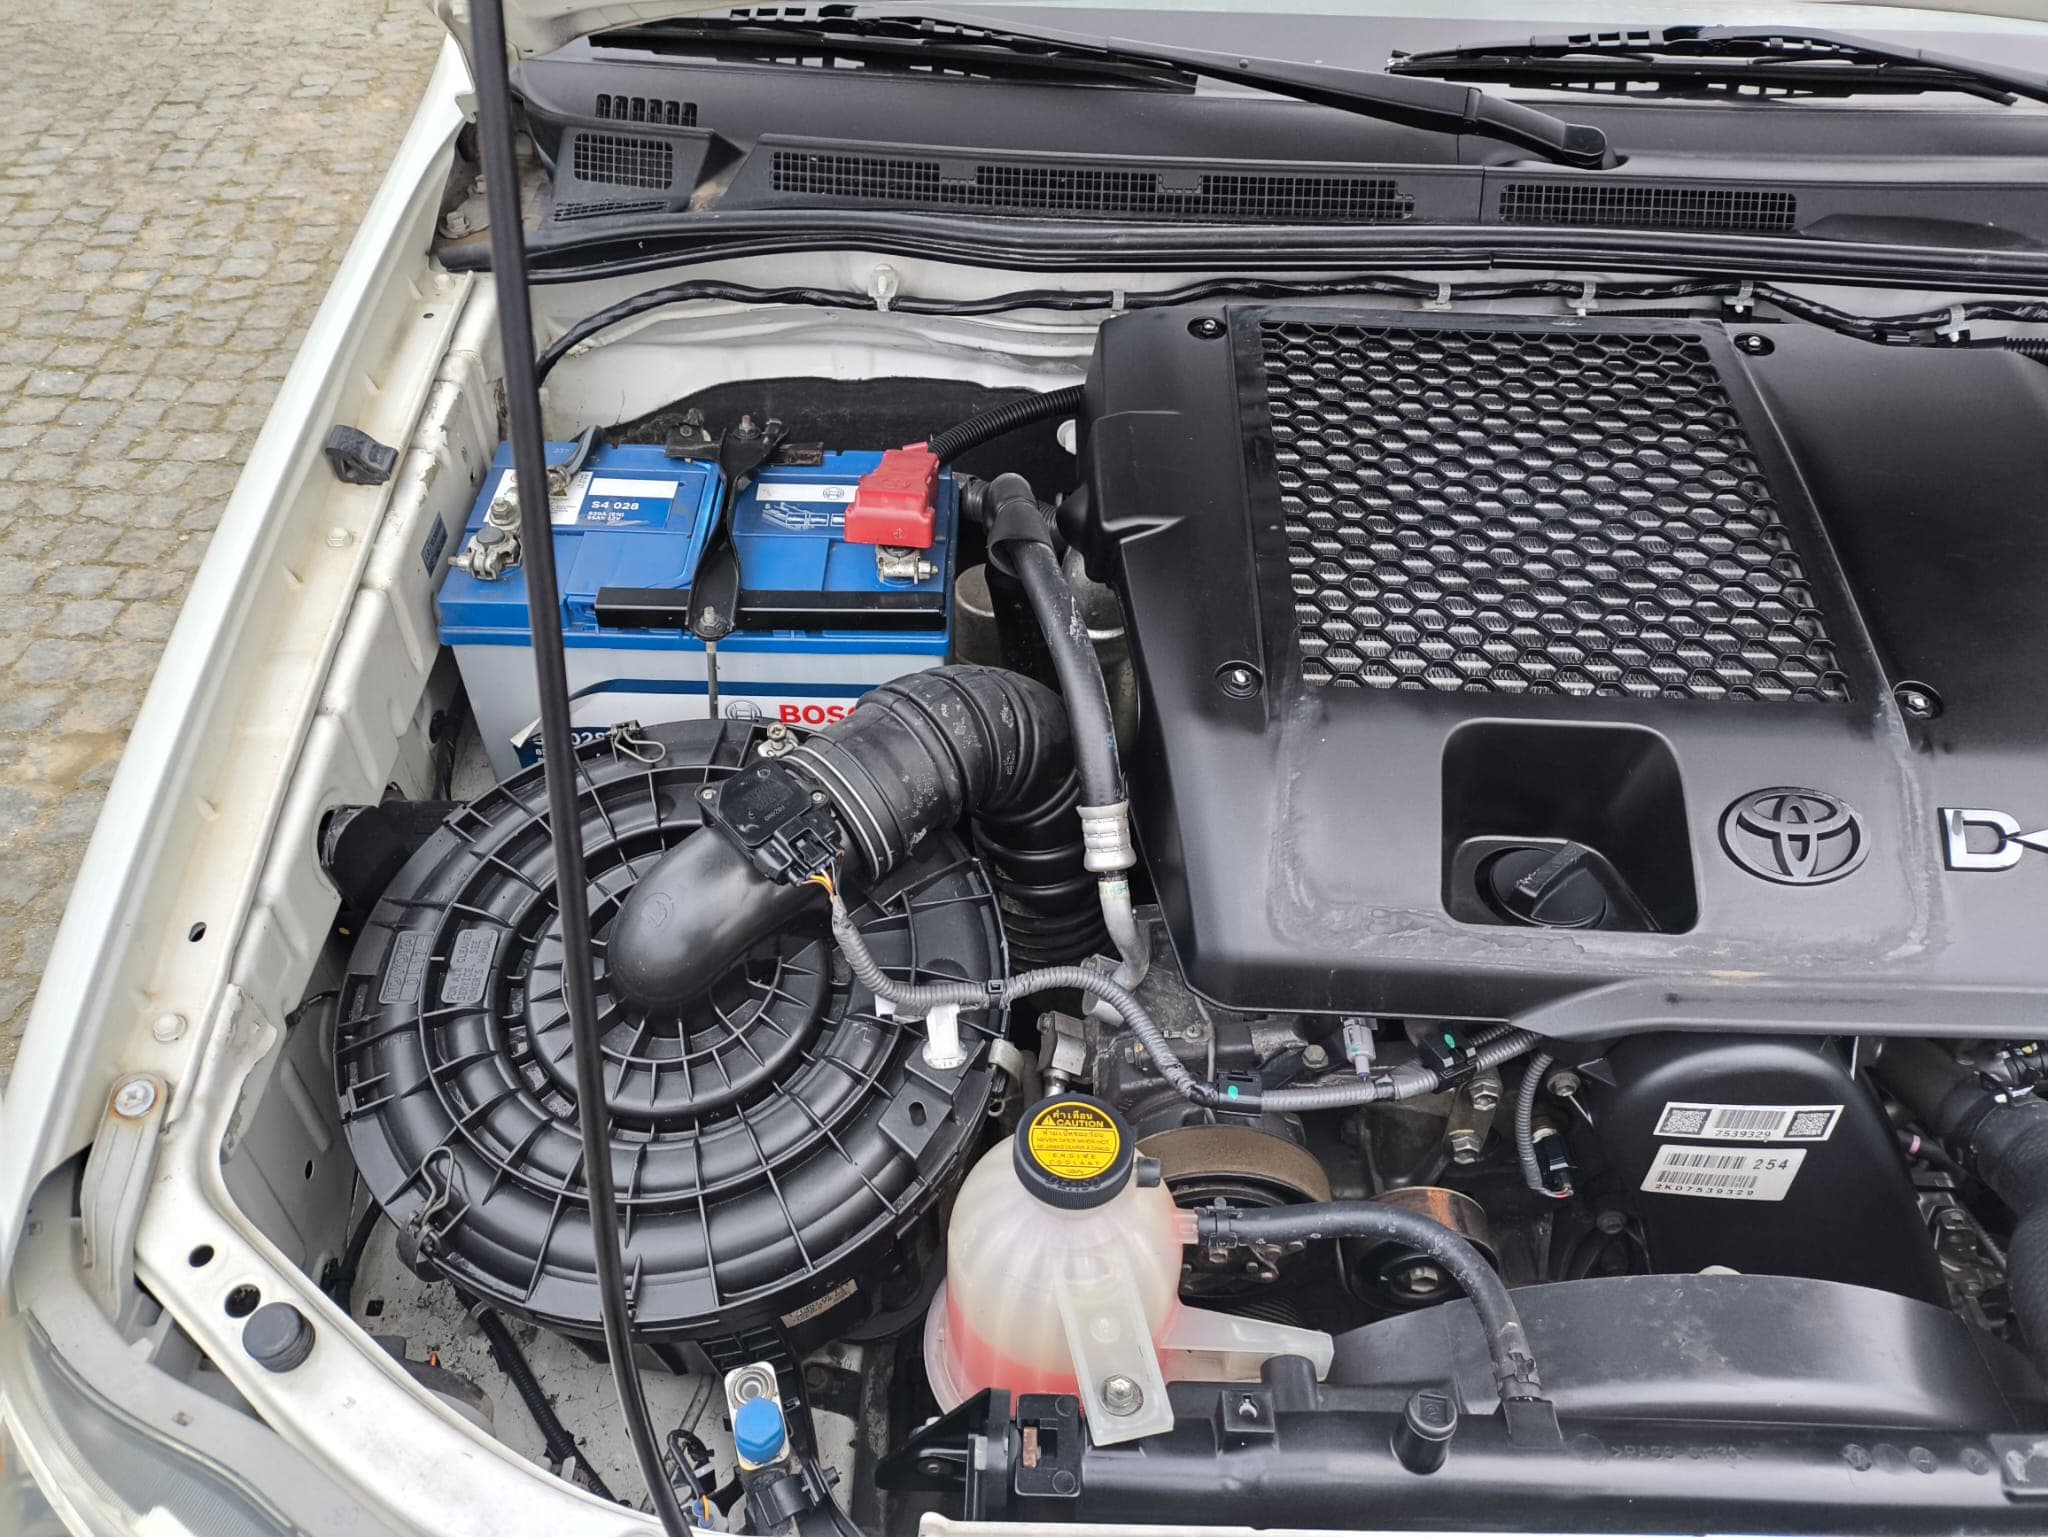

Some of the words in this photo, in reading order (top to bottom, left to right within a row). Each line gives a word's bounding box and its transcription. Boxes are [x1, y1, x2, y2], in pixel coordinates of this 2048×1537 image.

[591, 500, 609, 509] S4
[613, 501, 640, 511] 028
[779, 704, 856, 724] BOS
[383, 935, 414, 998] TOYOTA
[1056, 1119, 1104, 1128] CAUTION
[1714, 1129, 1772, 1138] 7539329
[1053, 1152, 1096, 1160] ENGINE
[1752, 1159, 1789, 1170] 254
